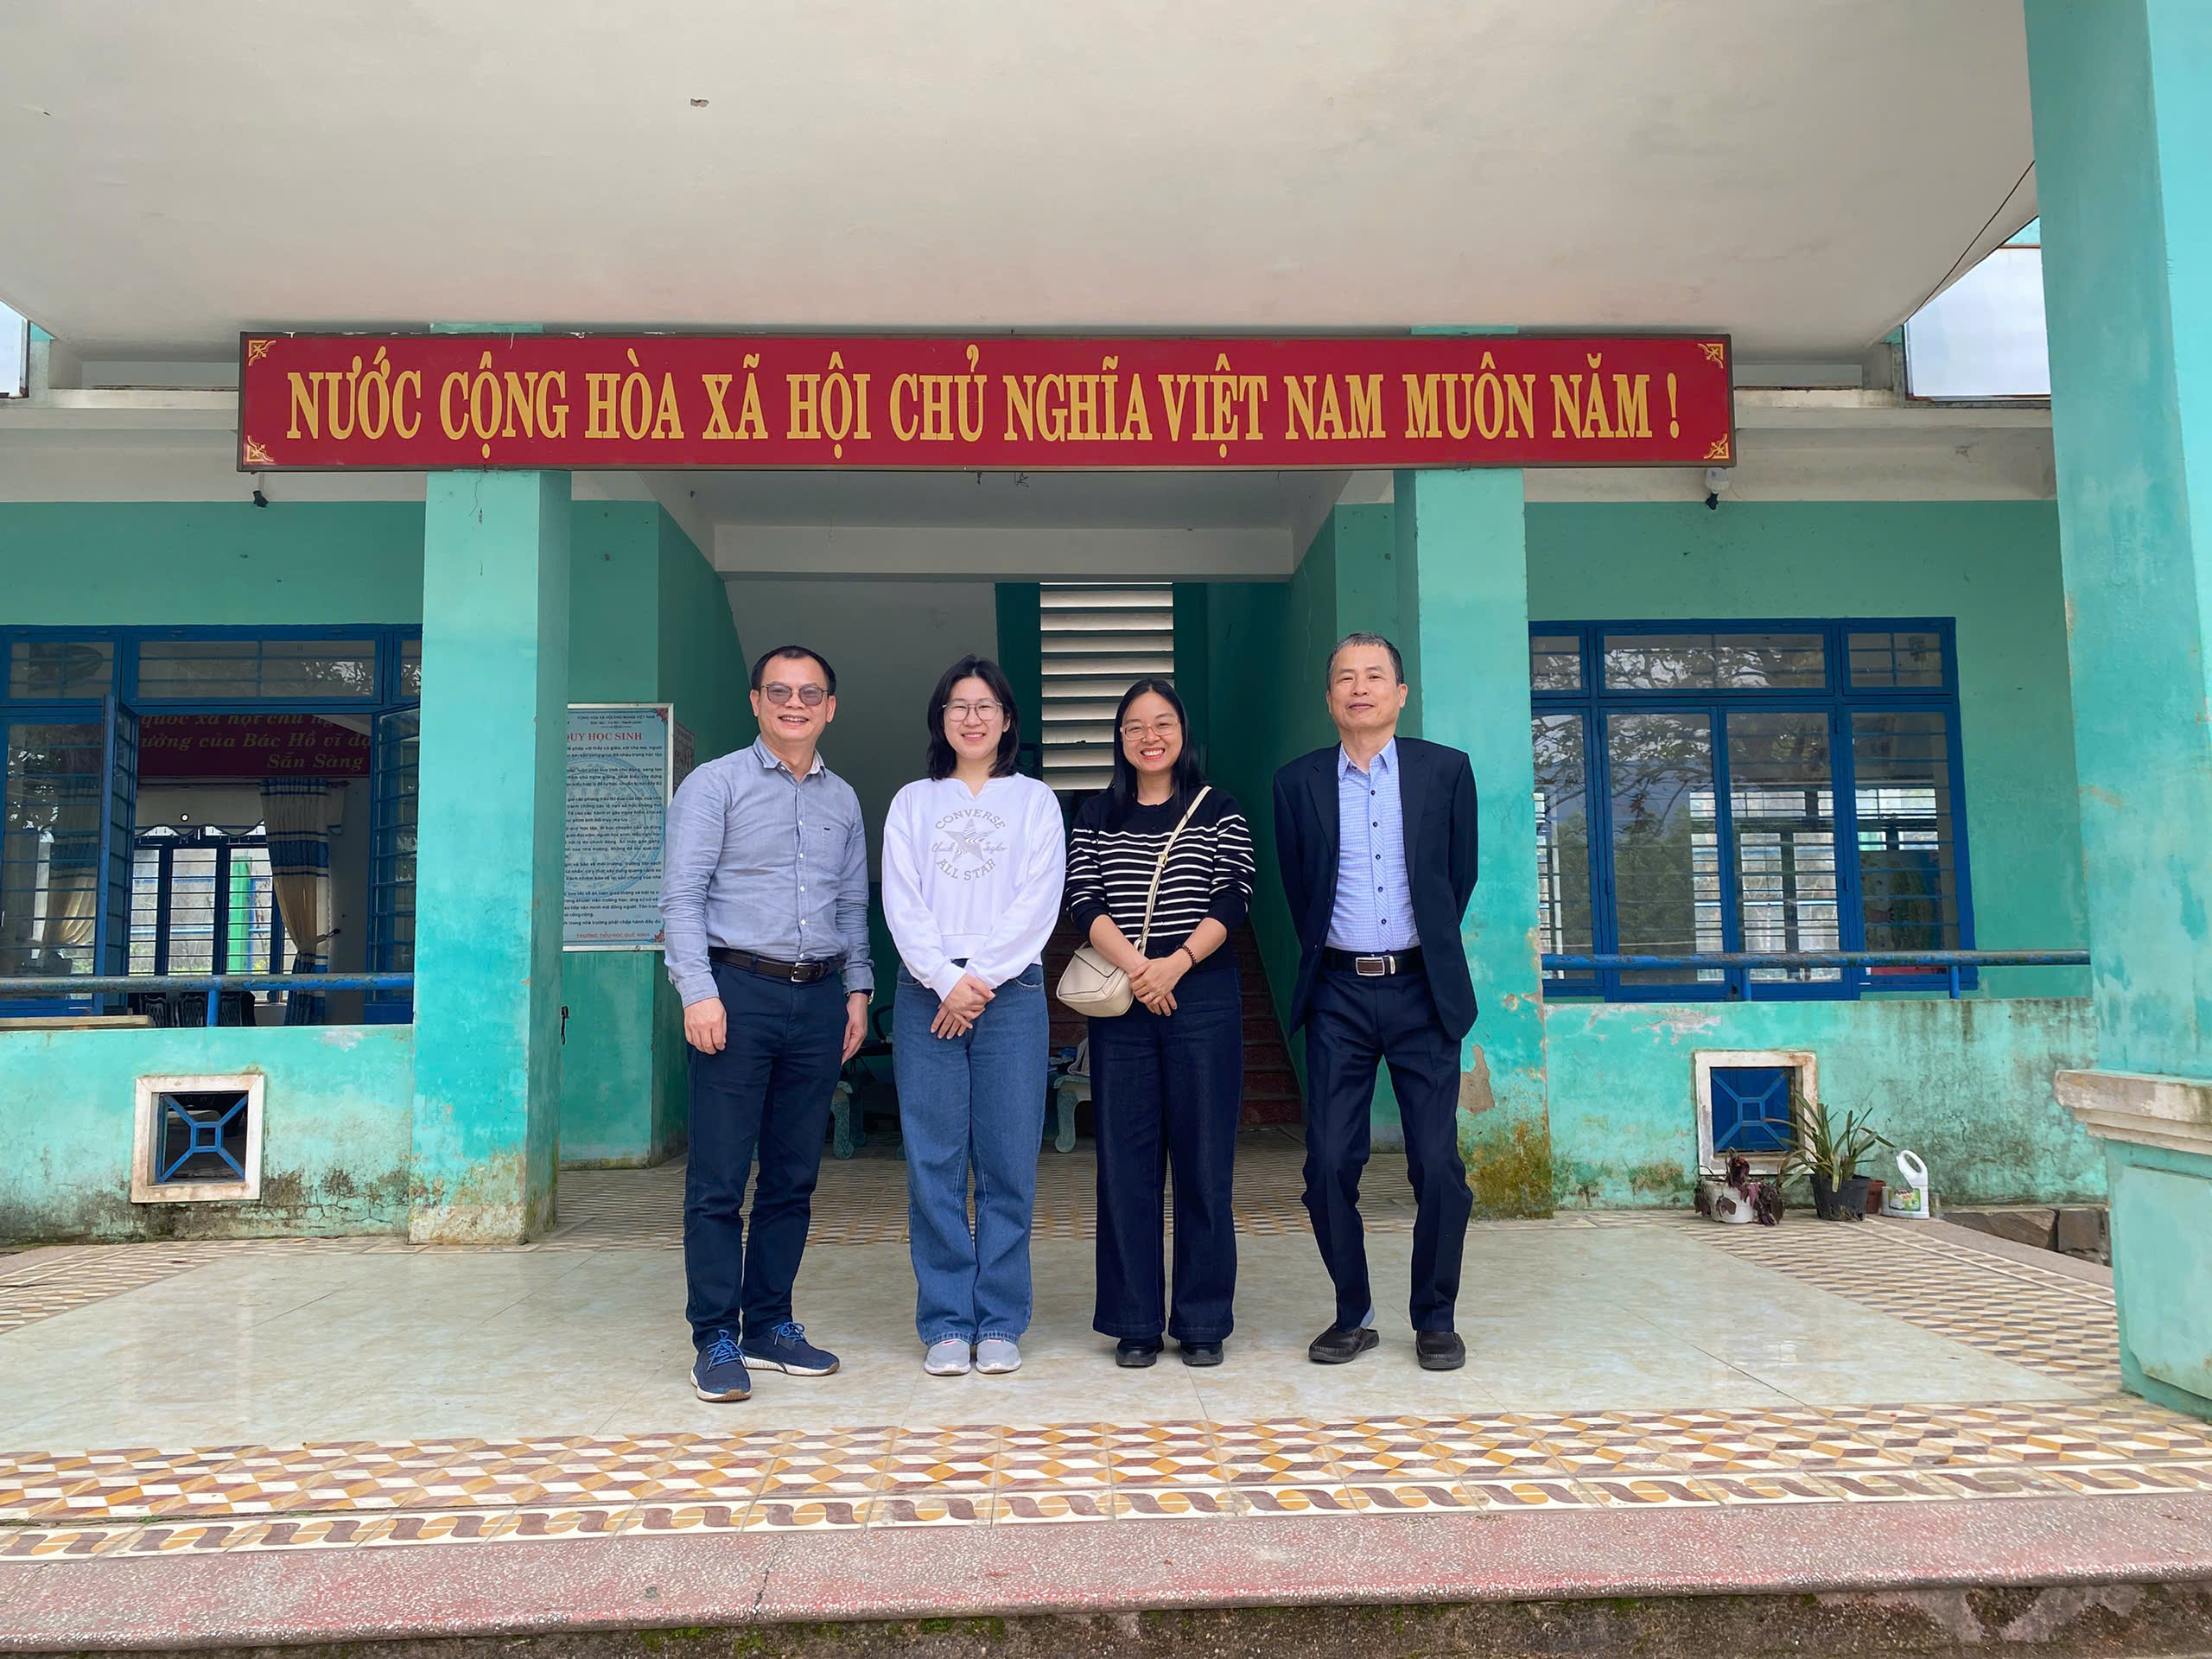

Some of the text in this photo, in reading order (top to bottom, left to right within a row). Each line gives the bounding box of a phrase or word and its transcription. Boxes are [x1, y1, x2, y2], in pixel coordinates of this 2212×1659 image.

[286, 344, 1680, 459] NƯỚC CỘNG HÒA XÃ HỘI CHỦ NGHĨA VIỆT NAM MUÔN NĂM !
[142, 733, 194, 752] ưởng
[200, 733, 236, 747] của
[243, 732, 283, 747] Bác
[289, 728, 318, 747] Hồ
[324, 733, 343, 747] vĩ
[588, 733, 612, 742] HỌC
[267, 752, 365, 772] Sẵn Sàng
[935, 809, 1006, 830] CONVERSE
[936, 858, 996, 881] ALL STAR
